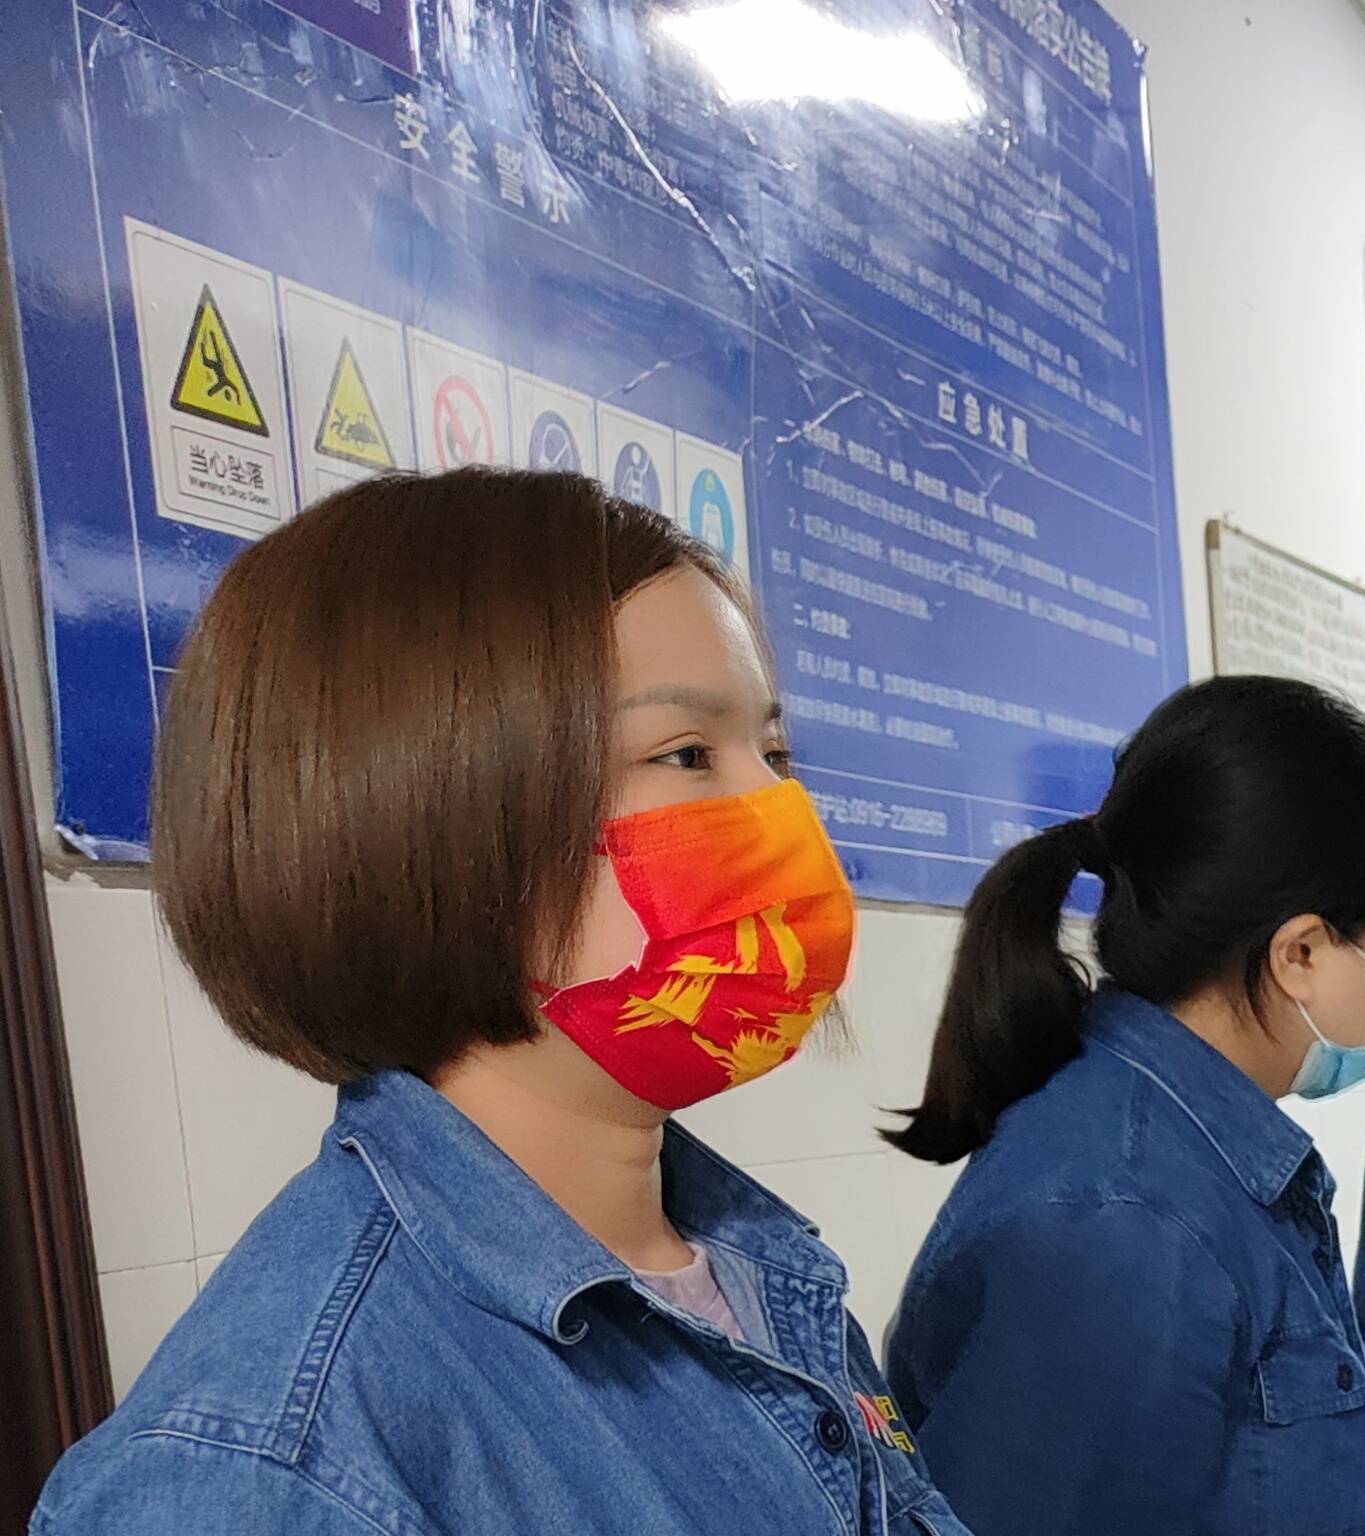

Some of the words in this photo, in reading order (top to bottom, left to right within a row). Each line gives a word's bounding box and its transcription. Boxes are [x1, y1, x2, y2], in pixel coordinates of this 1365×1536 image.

[394, 92, 572, 224] 安全警示
[938, 380, 1029, 461] 应急处置
[190, 444, 264, 489] 当心坠落
